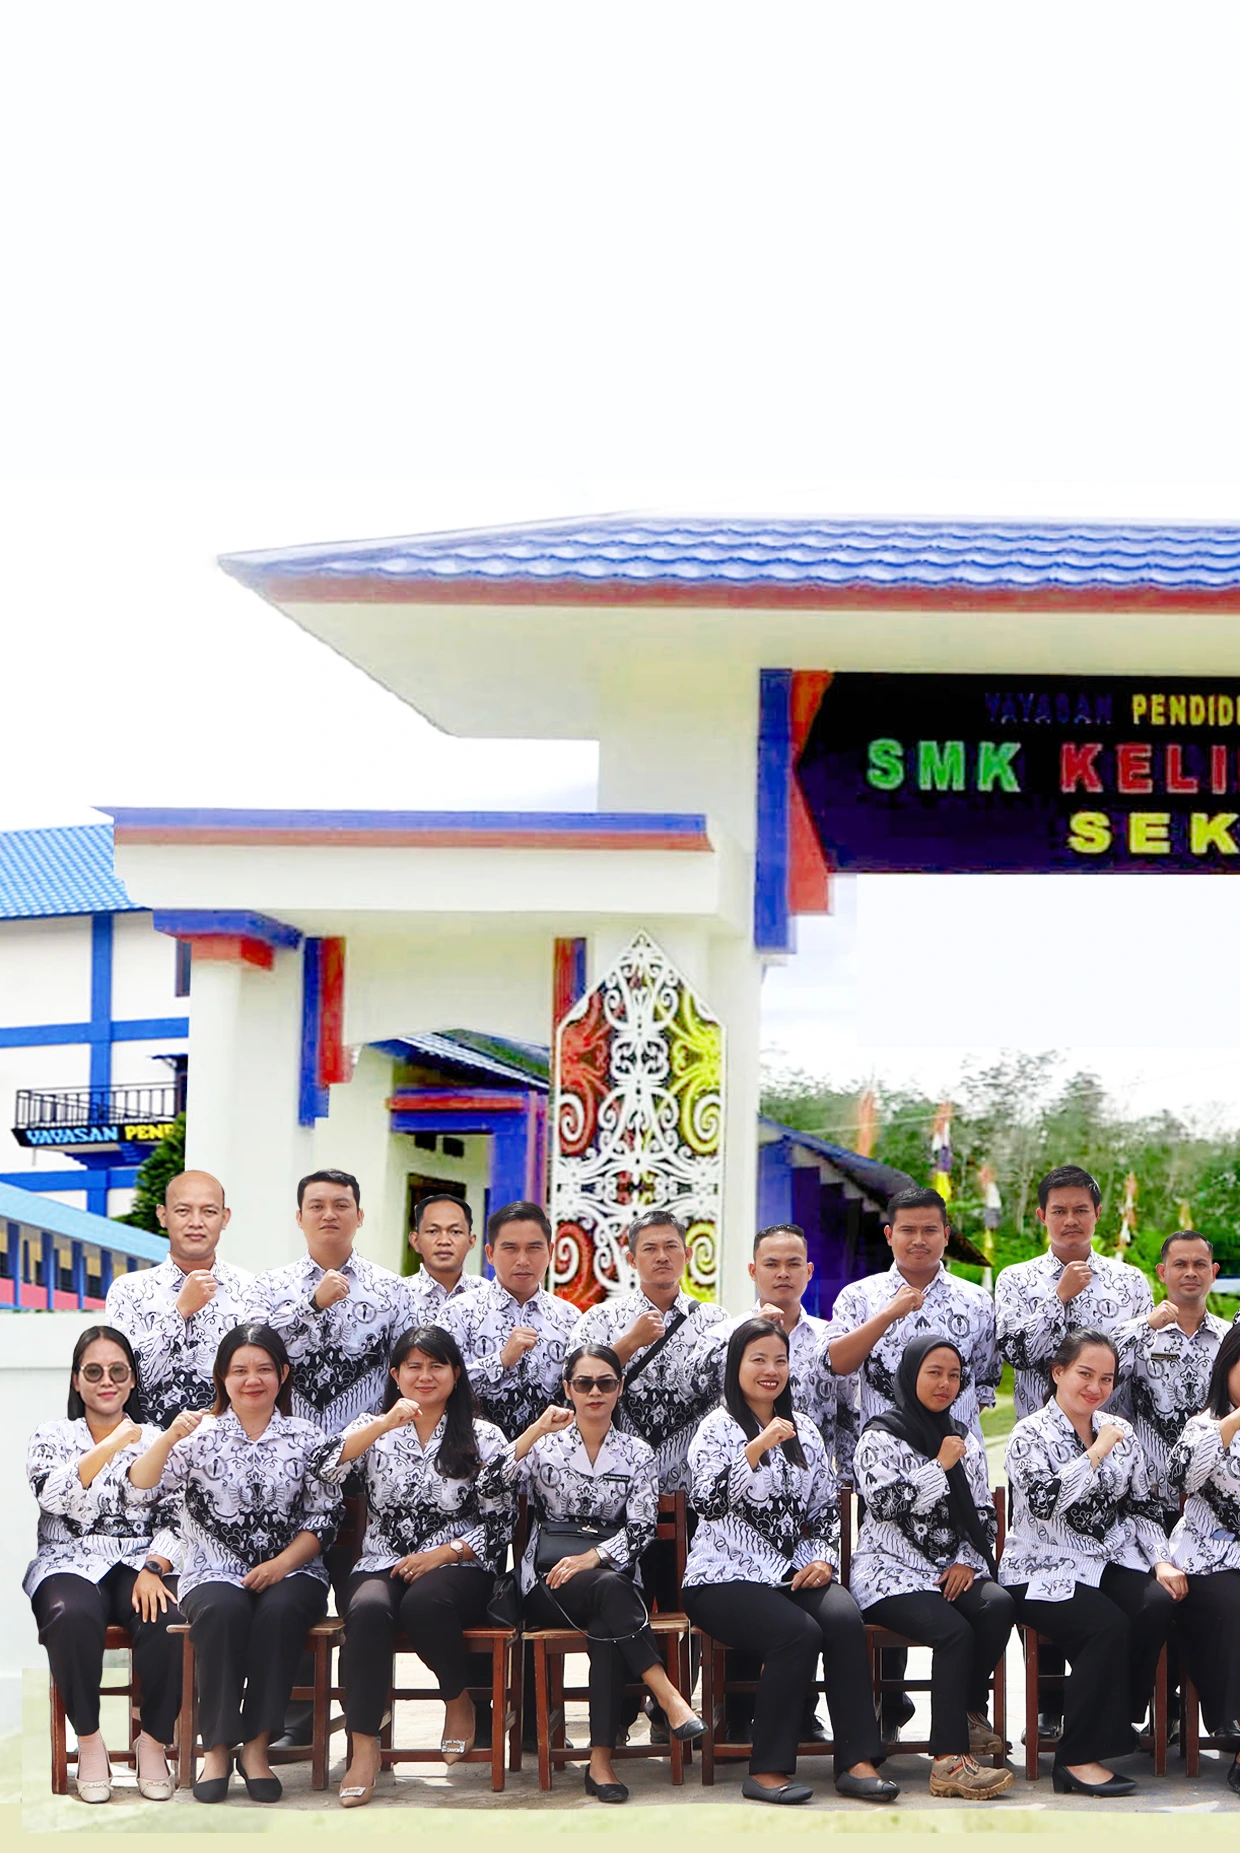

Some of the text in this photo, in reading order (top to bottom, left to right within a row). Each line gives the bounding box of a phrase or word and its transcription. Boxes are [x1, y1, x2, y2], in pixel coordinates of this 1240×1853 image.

[985, 693, 1112, 725] YAYASAN
[868, 740, 1022, 792] SMK
[26, 1127, 118, 1144] YAYASAN
